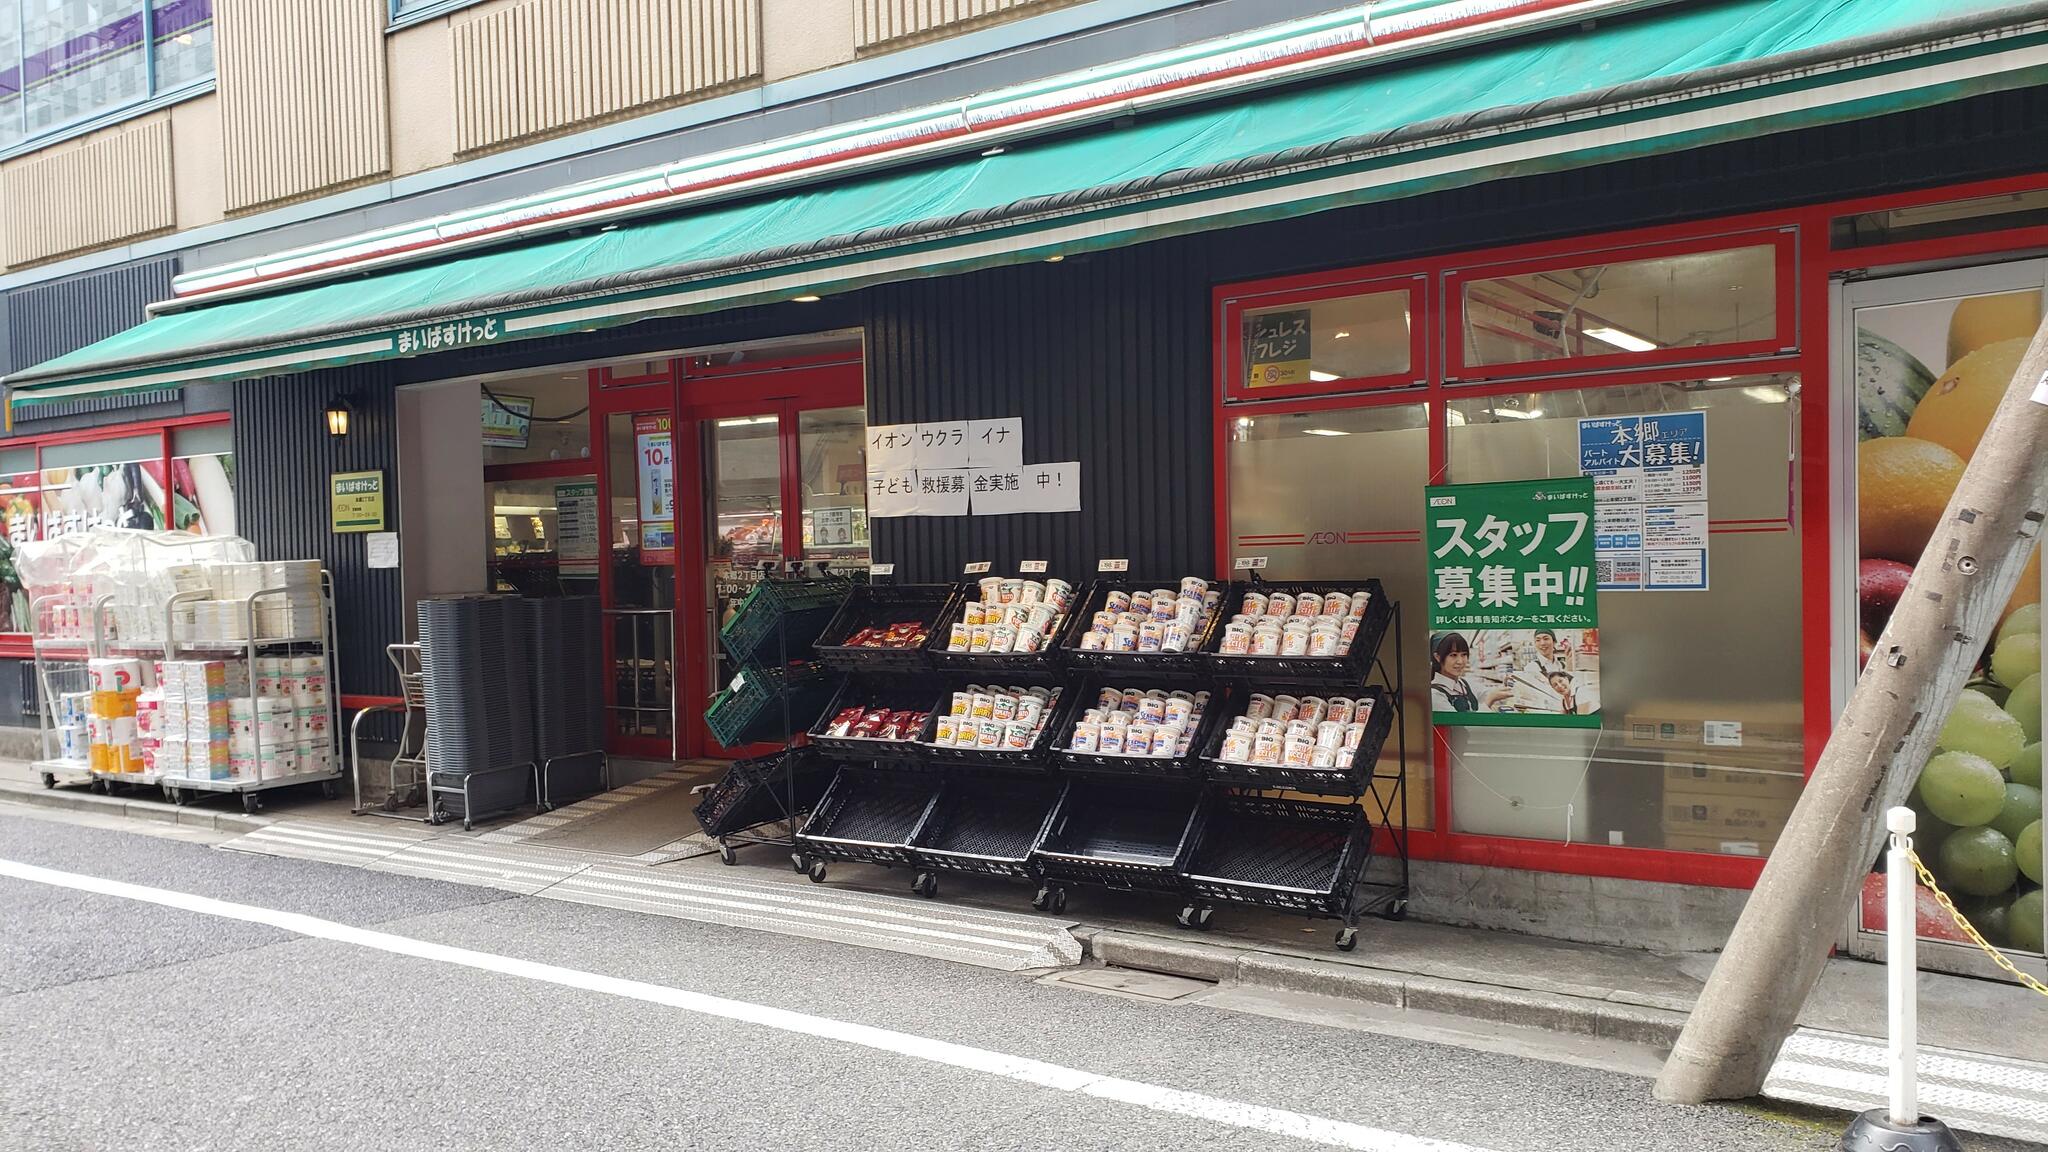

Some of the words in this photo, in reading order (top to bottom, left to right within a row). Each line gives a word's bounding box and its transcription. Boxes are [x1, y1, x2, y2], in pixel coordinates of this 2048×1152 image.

[398, 318, 498, 353] まいばすけっと
[872, 427, 1010, 449] イオンウクライナ
[1610, 421, 1659, 445] 本郷
[1547, 492, 1588, 500] まいばすけっと
[1433, 512, 1589, 559] スタッフ
[1436, 615, 1592, 624] 詳しくは募集告知ポスターをご覧ください。
